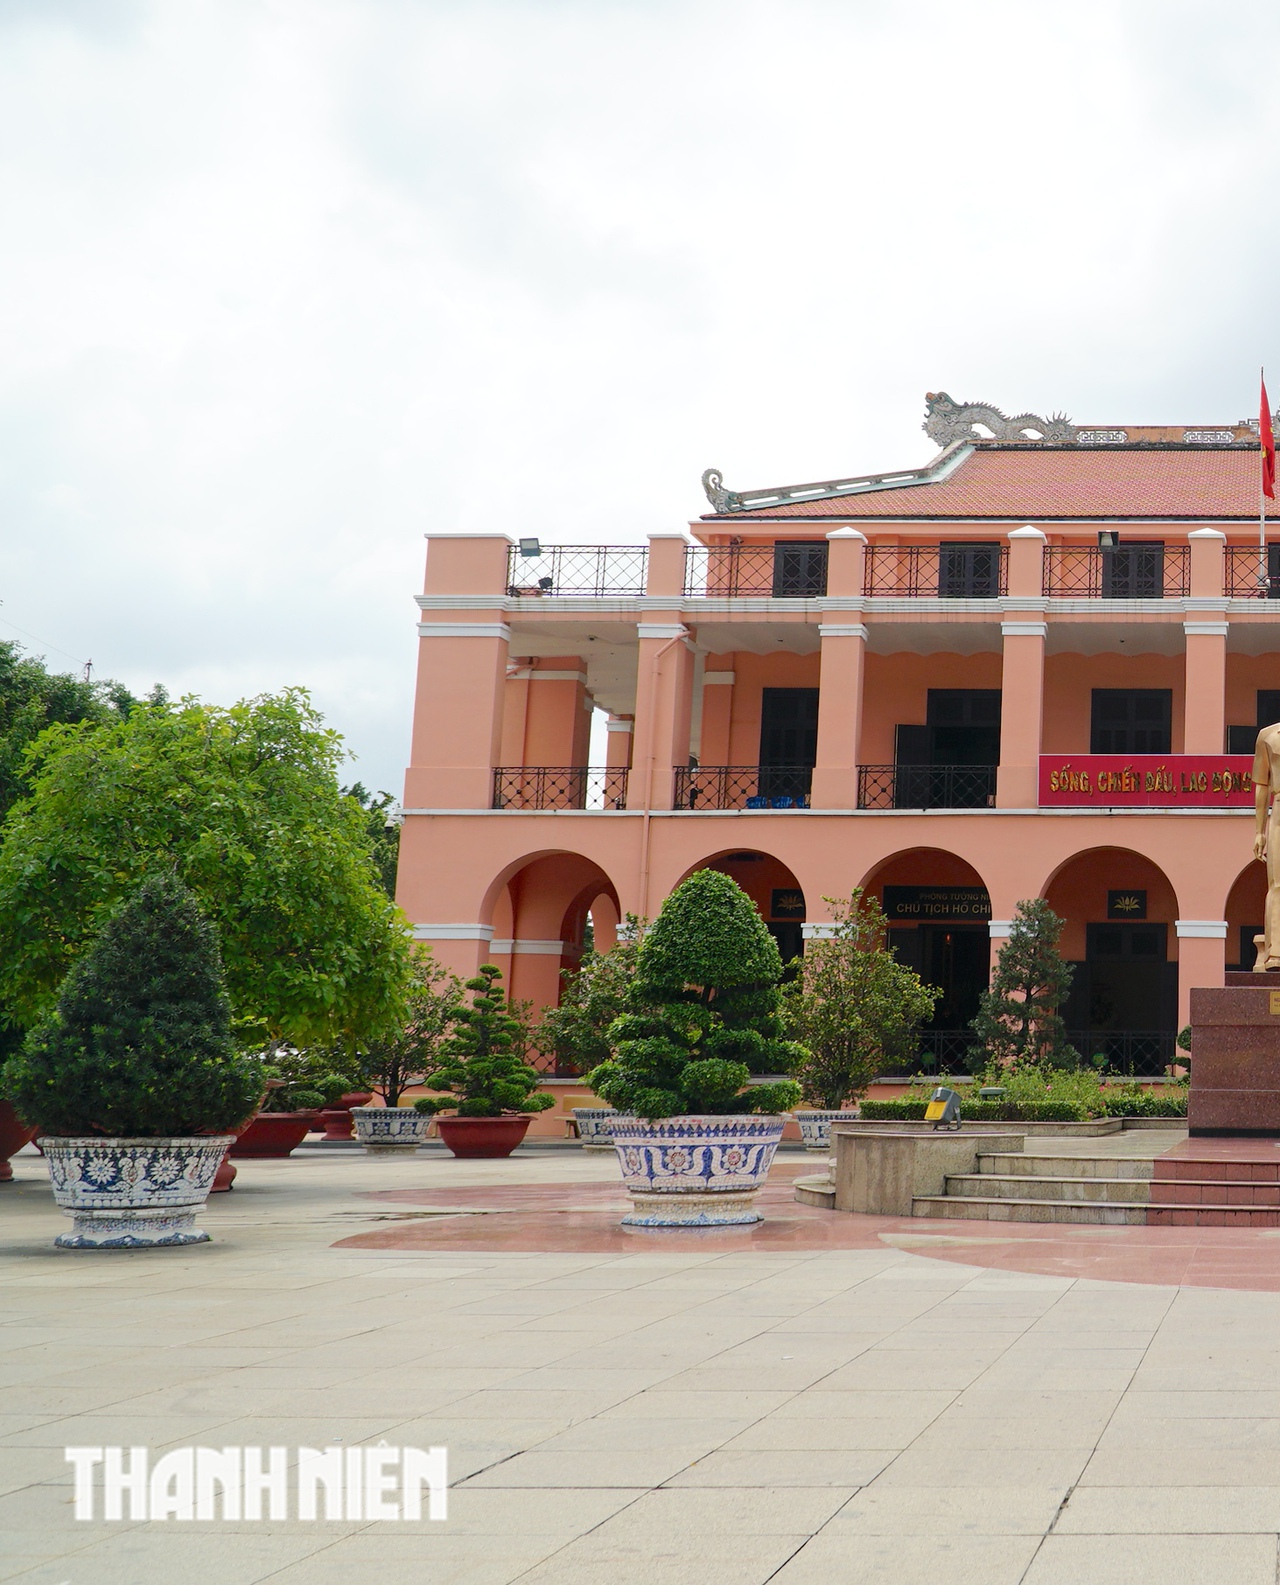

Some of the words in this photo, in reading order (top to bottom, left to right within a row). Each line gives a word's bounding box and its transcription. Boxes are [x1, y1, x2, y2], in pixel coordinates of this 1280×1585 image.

[1050, 764, 1094, 797] SỐNG,
[1097, 764, 1141, 793] CHIẾN
[1144, 765, 1177, 797] ĐẤU,
[1180, 771, 1207, 793] LAO
[1211, 767, 1253, 798] ĐỘNG
[924, 904, 949, 915] TỊCH
